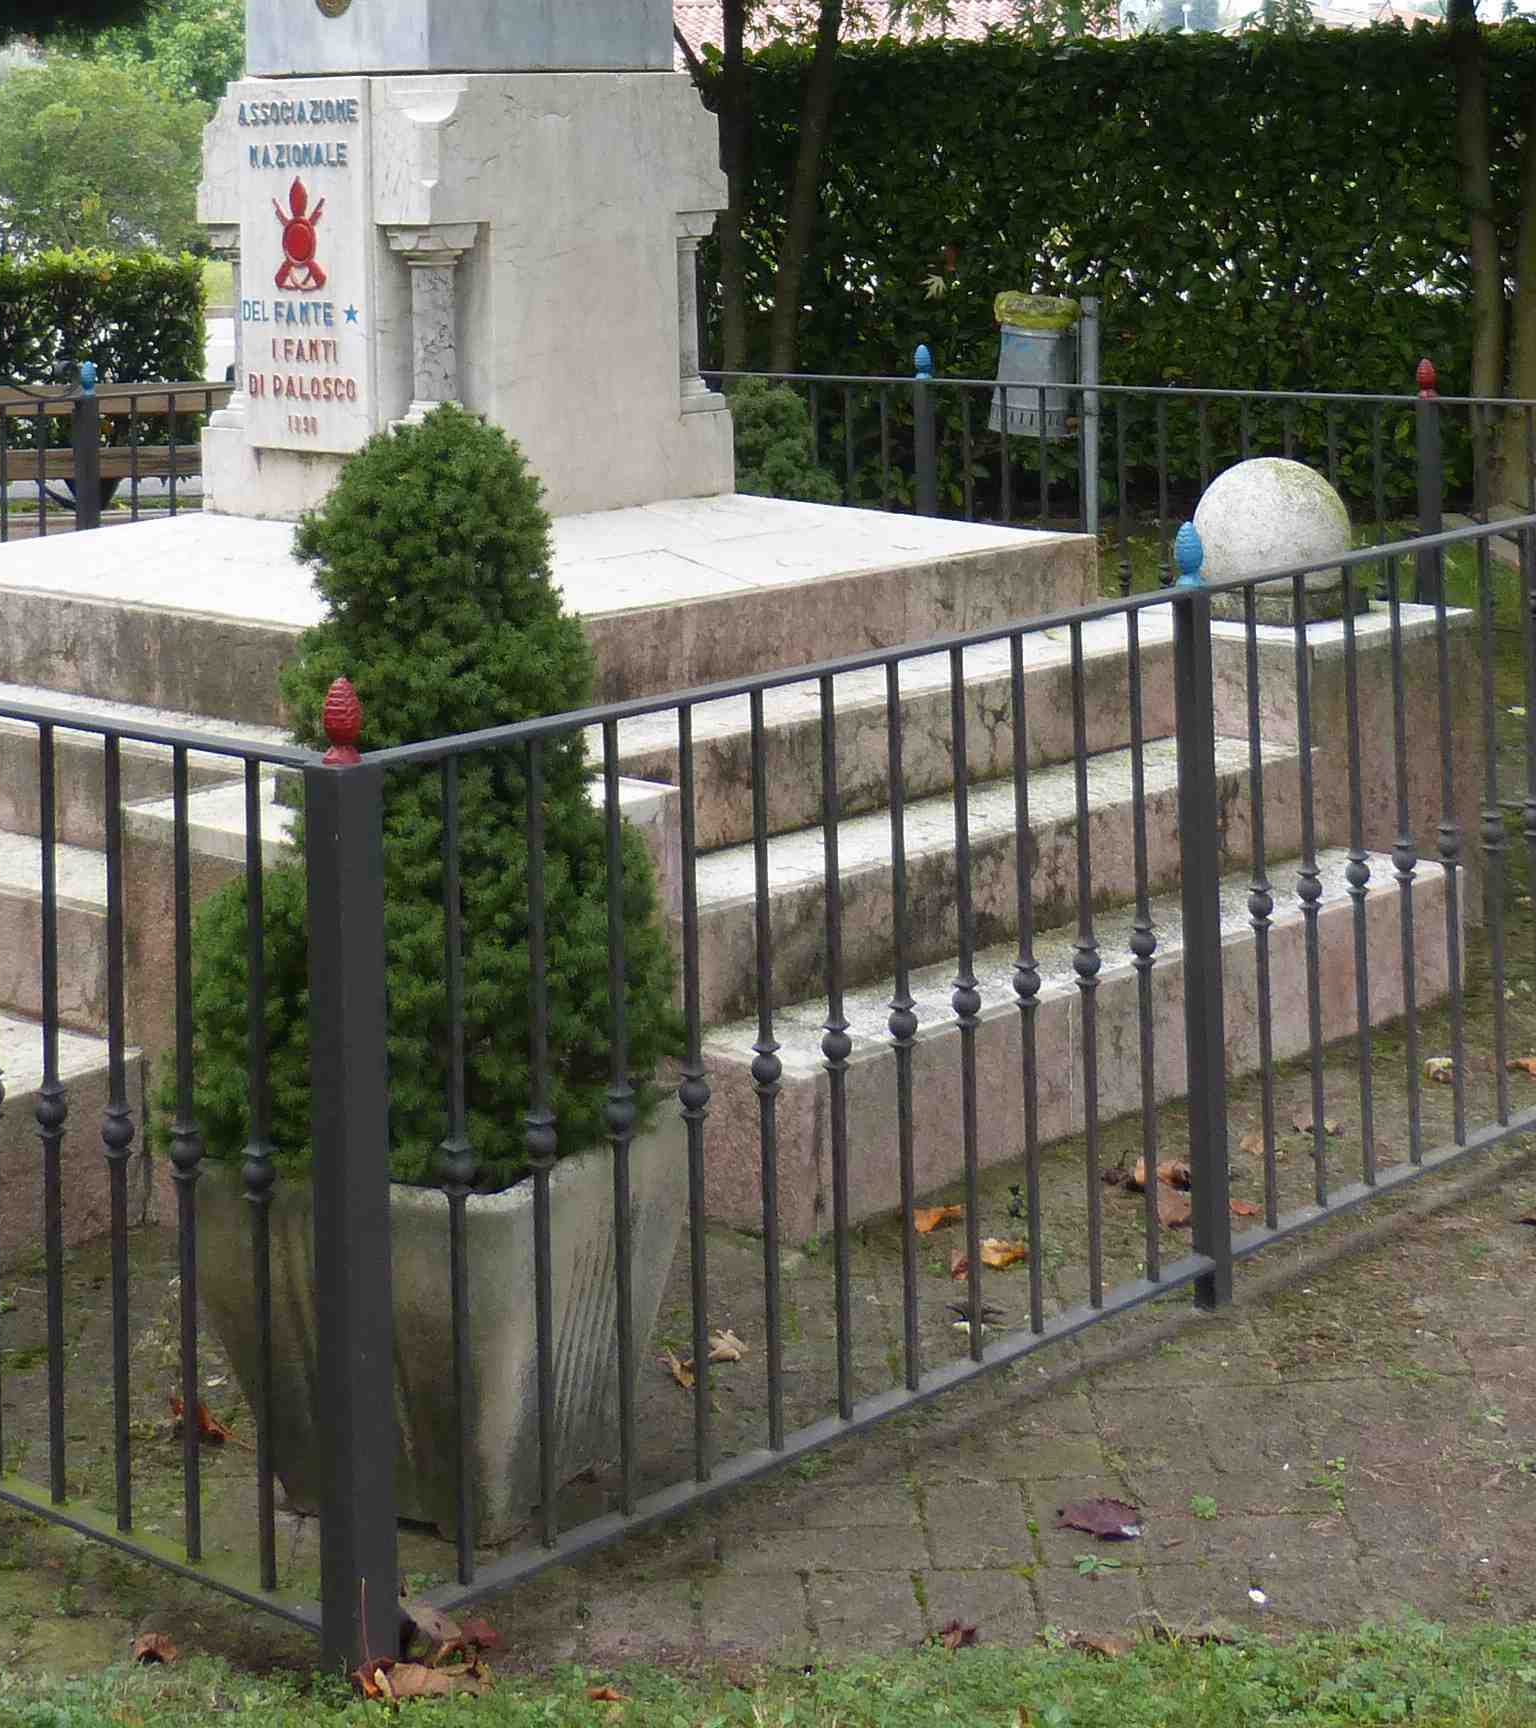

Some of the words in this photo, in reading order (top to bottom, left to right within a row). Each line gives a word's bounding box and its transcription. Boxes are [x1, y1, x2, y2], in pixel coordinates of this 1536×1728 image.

[238, 97, 359, 127] ASSOCIAZIONE
[249, 142, 349, 168] NAZIONALE
[242, 299, 270, 322] DEL
[274, 300, 335, 327] FANTE
[284, 338, 339, 365] FANTI
[248, 373, 265, 399] DI
[273, 374, 358, 402] PALOSCO
